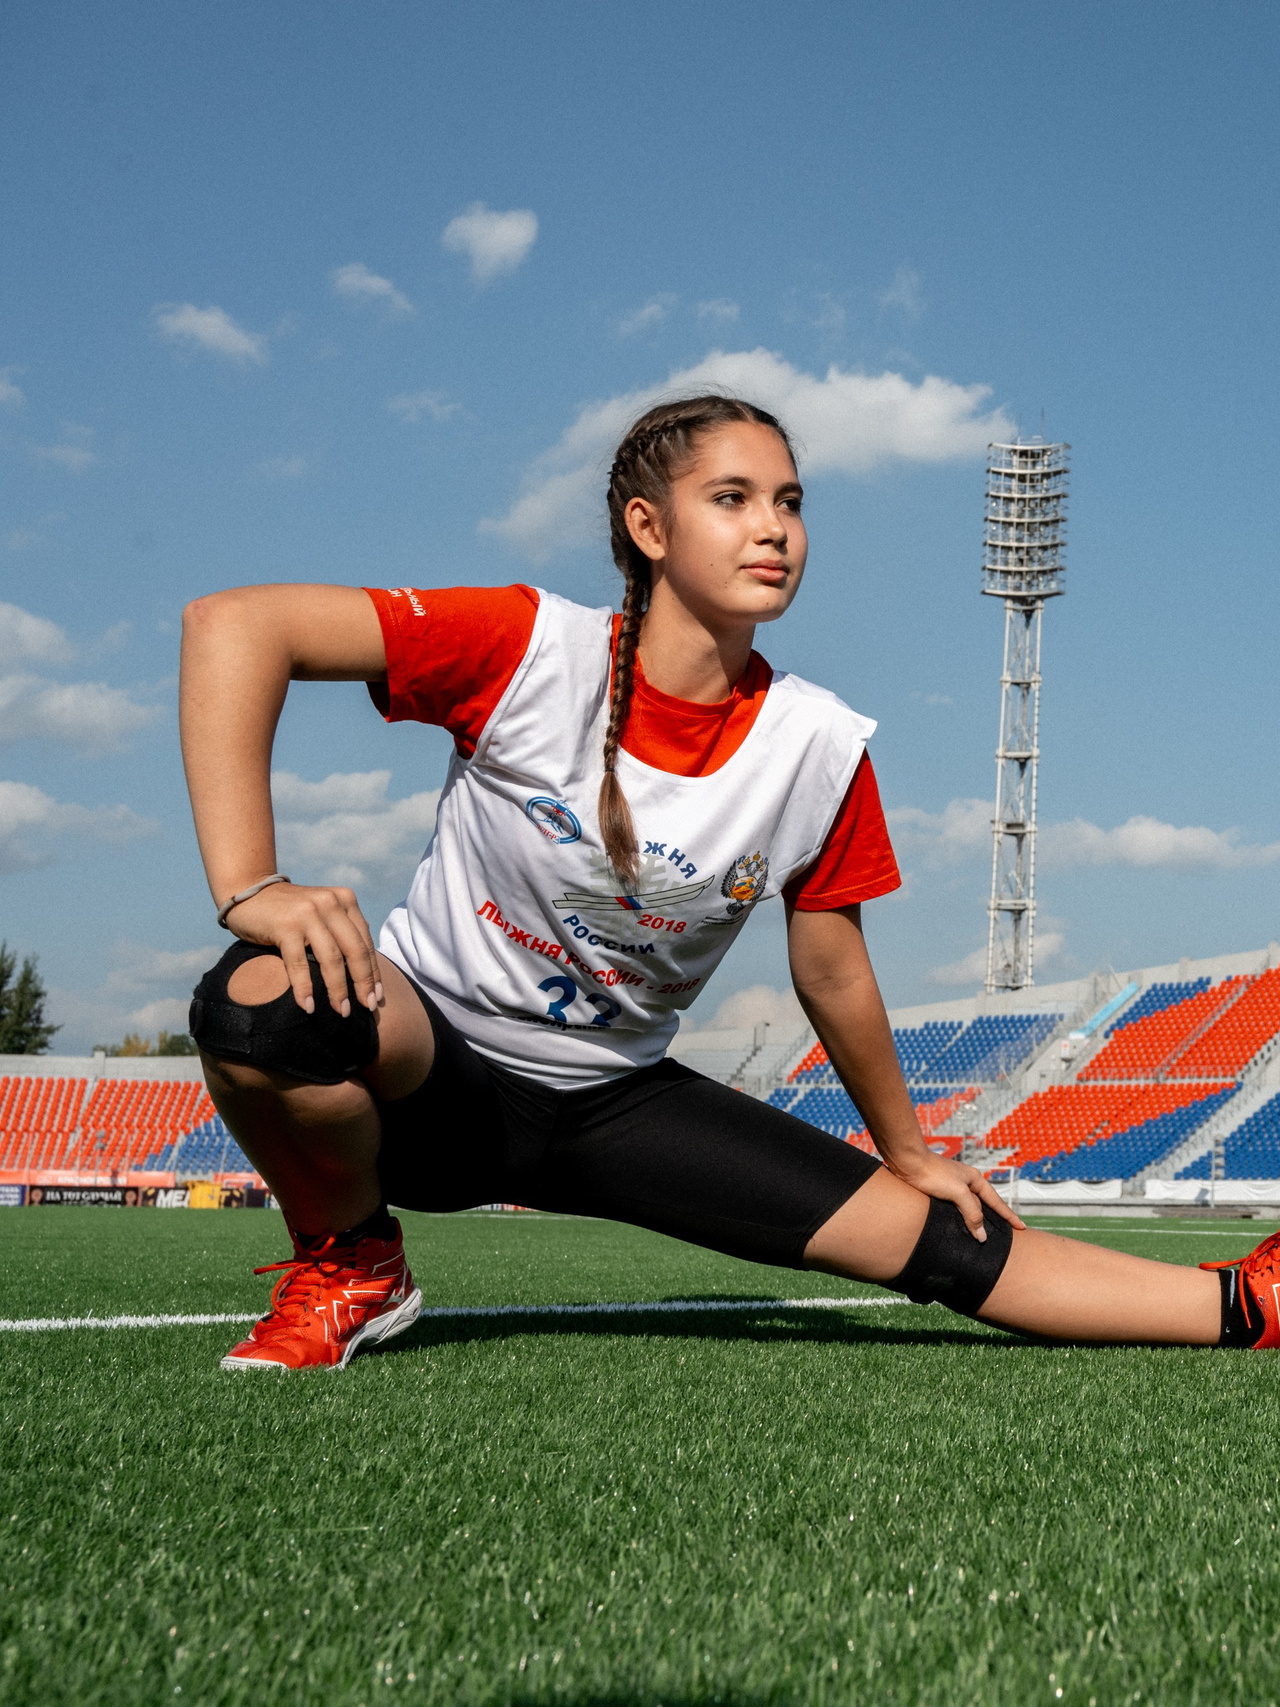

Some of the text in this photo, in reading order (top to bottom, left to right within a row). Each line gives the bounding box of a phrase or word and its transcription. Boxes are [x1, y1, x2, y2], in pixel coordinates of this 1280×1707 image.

[640, 840, 698, 880] ЖНЯ
[562, 914, 656, 954] РОССИИ
[637, 913, 687, 934] 2018
[476, 899, 563, 961] ЛЫЖНЯ
[565, 951, 646, 988] РОССИИ
[657, 976, 702, 995] 2018
